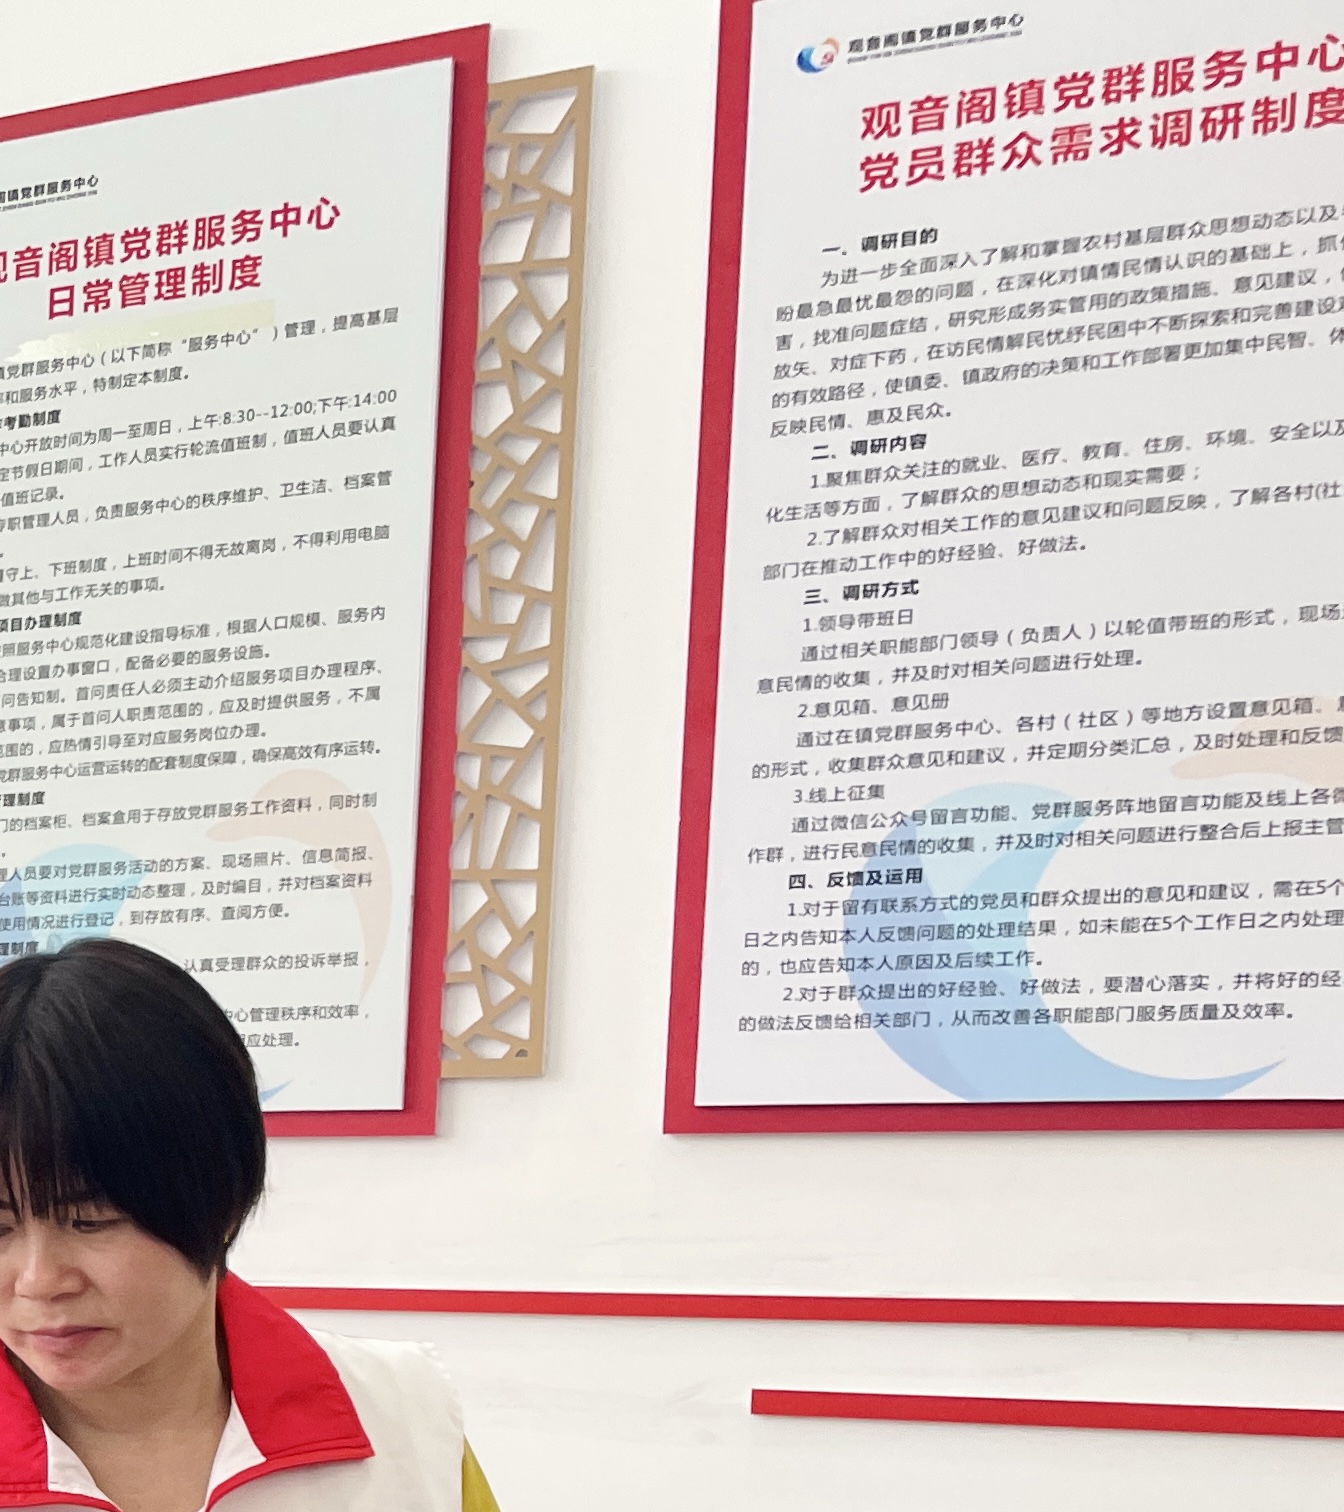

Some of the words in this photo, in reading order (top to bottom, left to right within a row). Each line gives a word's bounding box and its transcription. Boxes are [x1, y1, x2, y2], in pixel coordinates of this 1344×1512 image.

[859, 33, 1343, 141] 观音阁镇党群服务中心
[858, 86, 1344, 193] 党员群众需求调研制度
[820, 203, 1344, 288] 为进一步全面深入了解和掌握农村基层群众思想动态以及
[47, 253, 262, 320] 日常管理制度
[775, 266, 1344, 351] 害，找准问题症结，研究形成务实管用的政策措施、意见建议，
[769, 401, 951, 438] 反映民情、惠及民众。
[810, 432, 927, 460] 二、调研内容
[802, 578, 919, 605] 三、调研方式
[799, 603, 1344, 662] 通过相关职能部门领导（负责人）以轮值带班的形式，现场
[802, 608, 913, 632] 1.领导带班日
[792, 783, 885, 803] 3.线上征集
[787, 866, 923, 890] 四、反馈及运用
